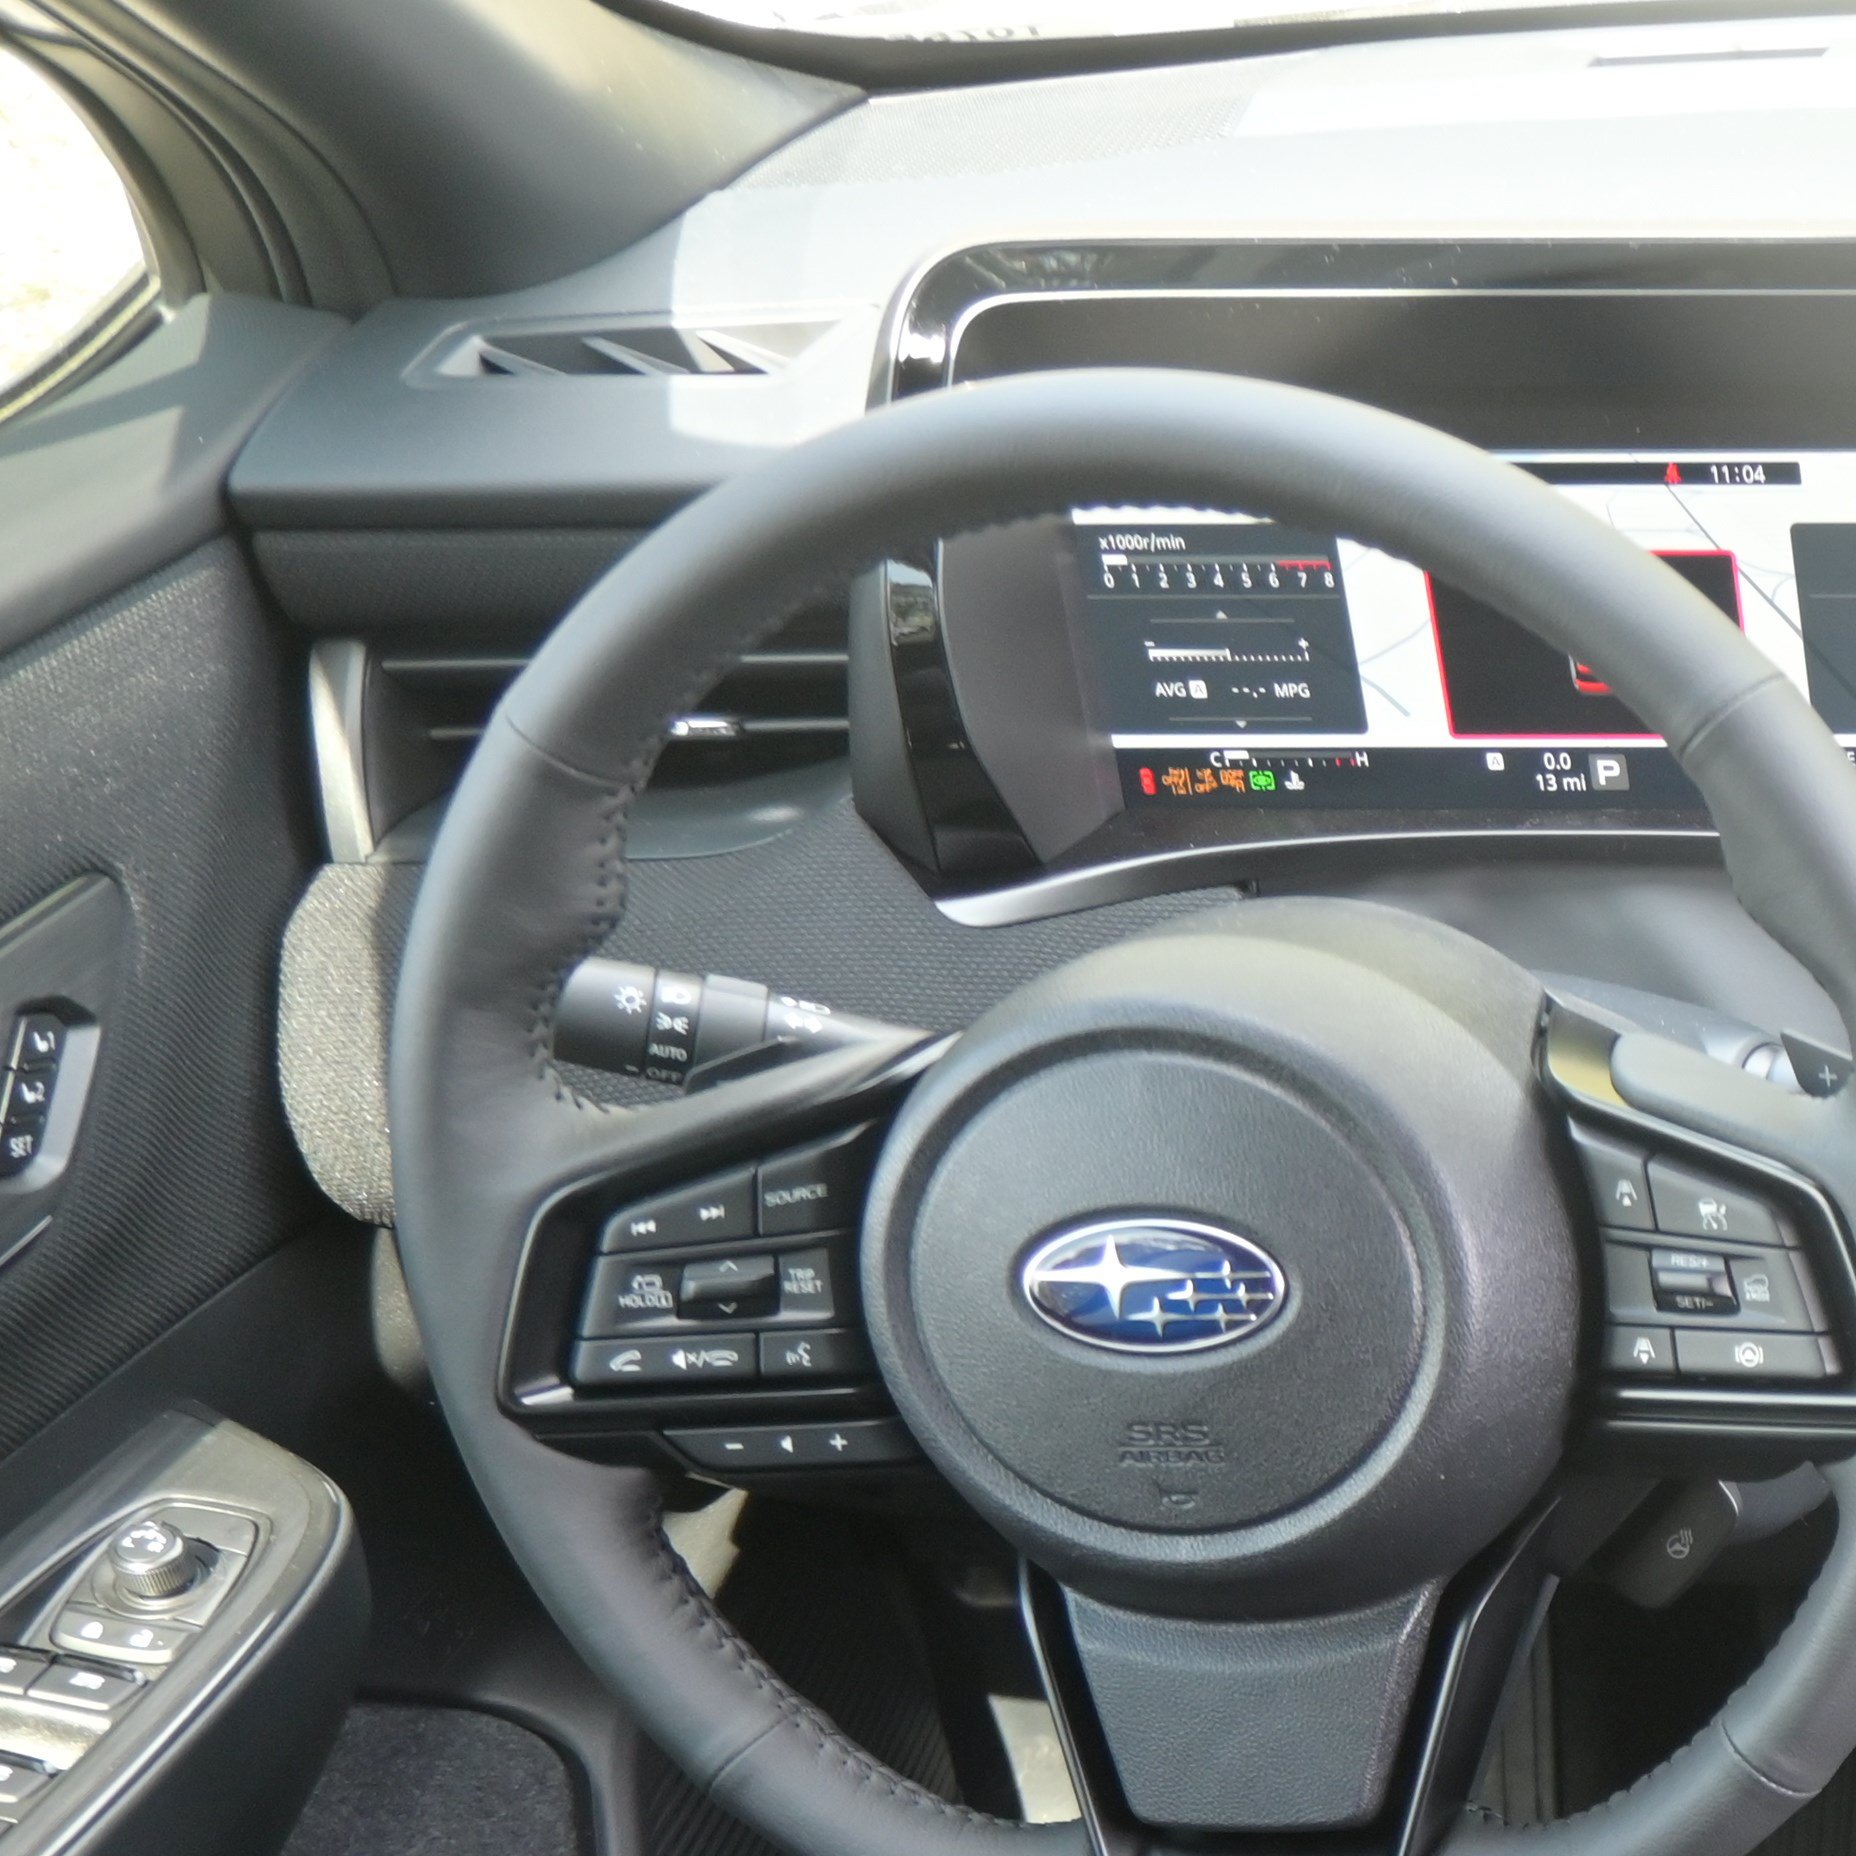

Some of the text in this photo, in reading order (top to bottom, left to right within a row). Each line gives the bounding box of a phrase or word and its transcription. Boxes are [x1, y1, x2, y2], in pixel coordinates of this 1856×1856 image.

[1710, 464, 1766, 484] 11:04
[1104, 572, 1335, 588] 0 1 2 3 4 5 6 7 8
[1155, 682, 1187, 698] AVG
[1273, 682, 1311, 698] MPG
[1355, 751, 1369, 767] H
[1543, 752, 1571, 771] 0.0
[1596, 758, 1621, 785] P
[1536, 773, 1587, 792] 13 mi
[650, 1042, 688, 1062] AUTO
[763, 1182, 828, 1207] SOURCE
[1125, 1422, 1210, 1446] SRS
[1118, 1449, 1225, 1465] AIRBAG
